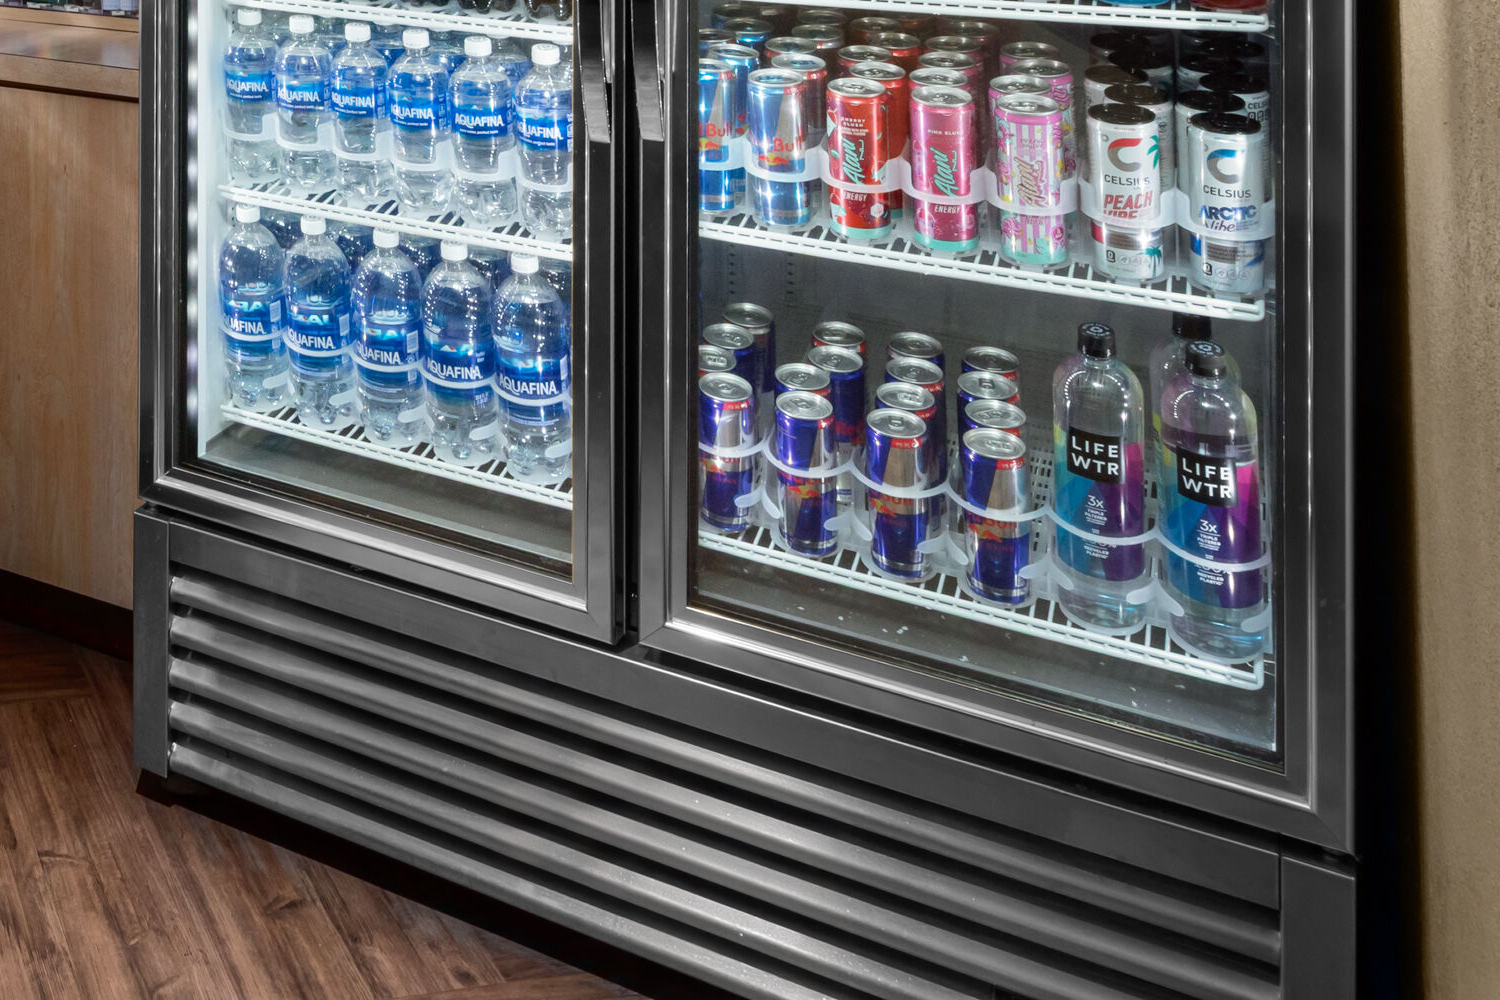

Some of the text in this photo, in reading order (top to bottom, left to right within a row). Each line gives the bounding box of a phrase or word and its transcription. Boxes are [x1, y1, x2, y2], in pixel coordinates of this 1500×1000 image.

[454, 112, 505, 129] AQUAFINA
[1104, 174, 1151, 186] CELSIUS
[842, 191, 867, 202] ENERGY
[1103, 190, 1153, 210] PEACH
[1202, 184, 1252, 199] CELSIUS
[934, 204, 961, 214] ENERGY
[287, 326, 336, 350] AQUAFINA
[426, 357, 484, 380] AQUAFINA
[500, 373, 560, 396] AQUAFINA
[1071, 434, 1119, 458] LIFE
[1071, 452, 1119, 476] WTR
[1181, 459, 1233, 482] LIFE
[1181, 475, 1233, 499] WTR
[1198, 575, 1224, 587] PLASTIC
